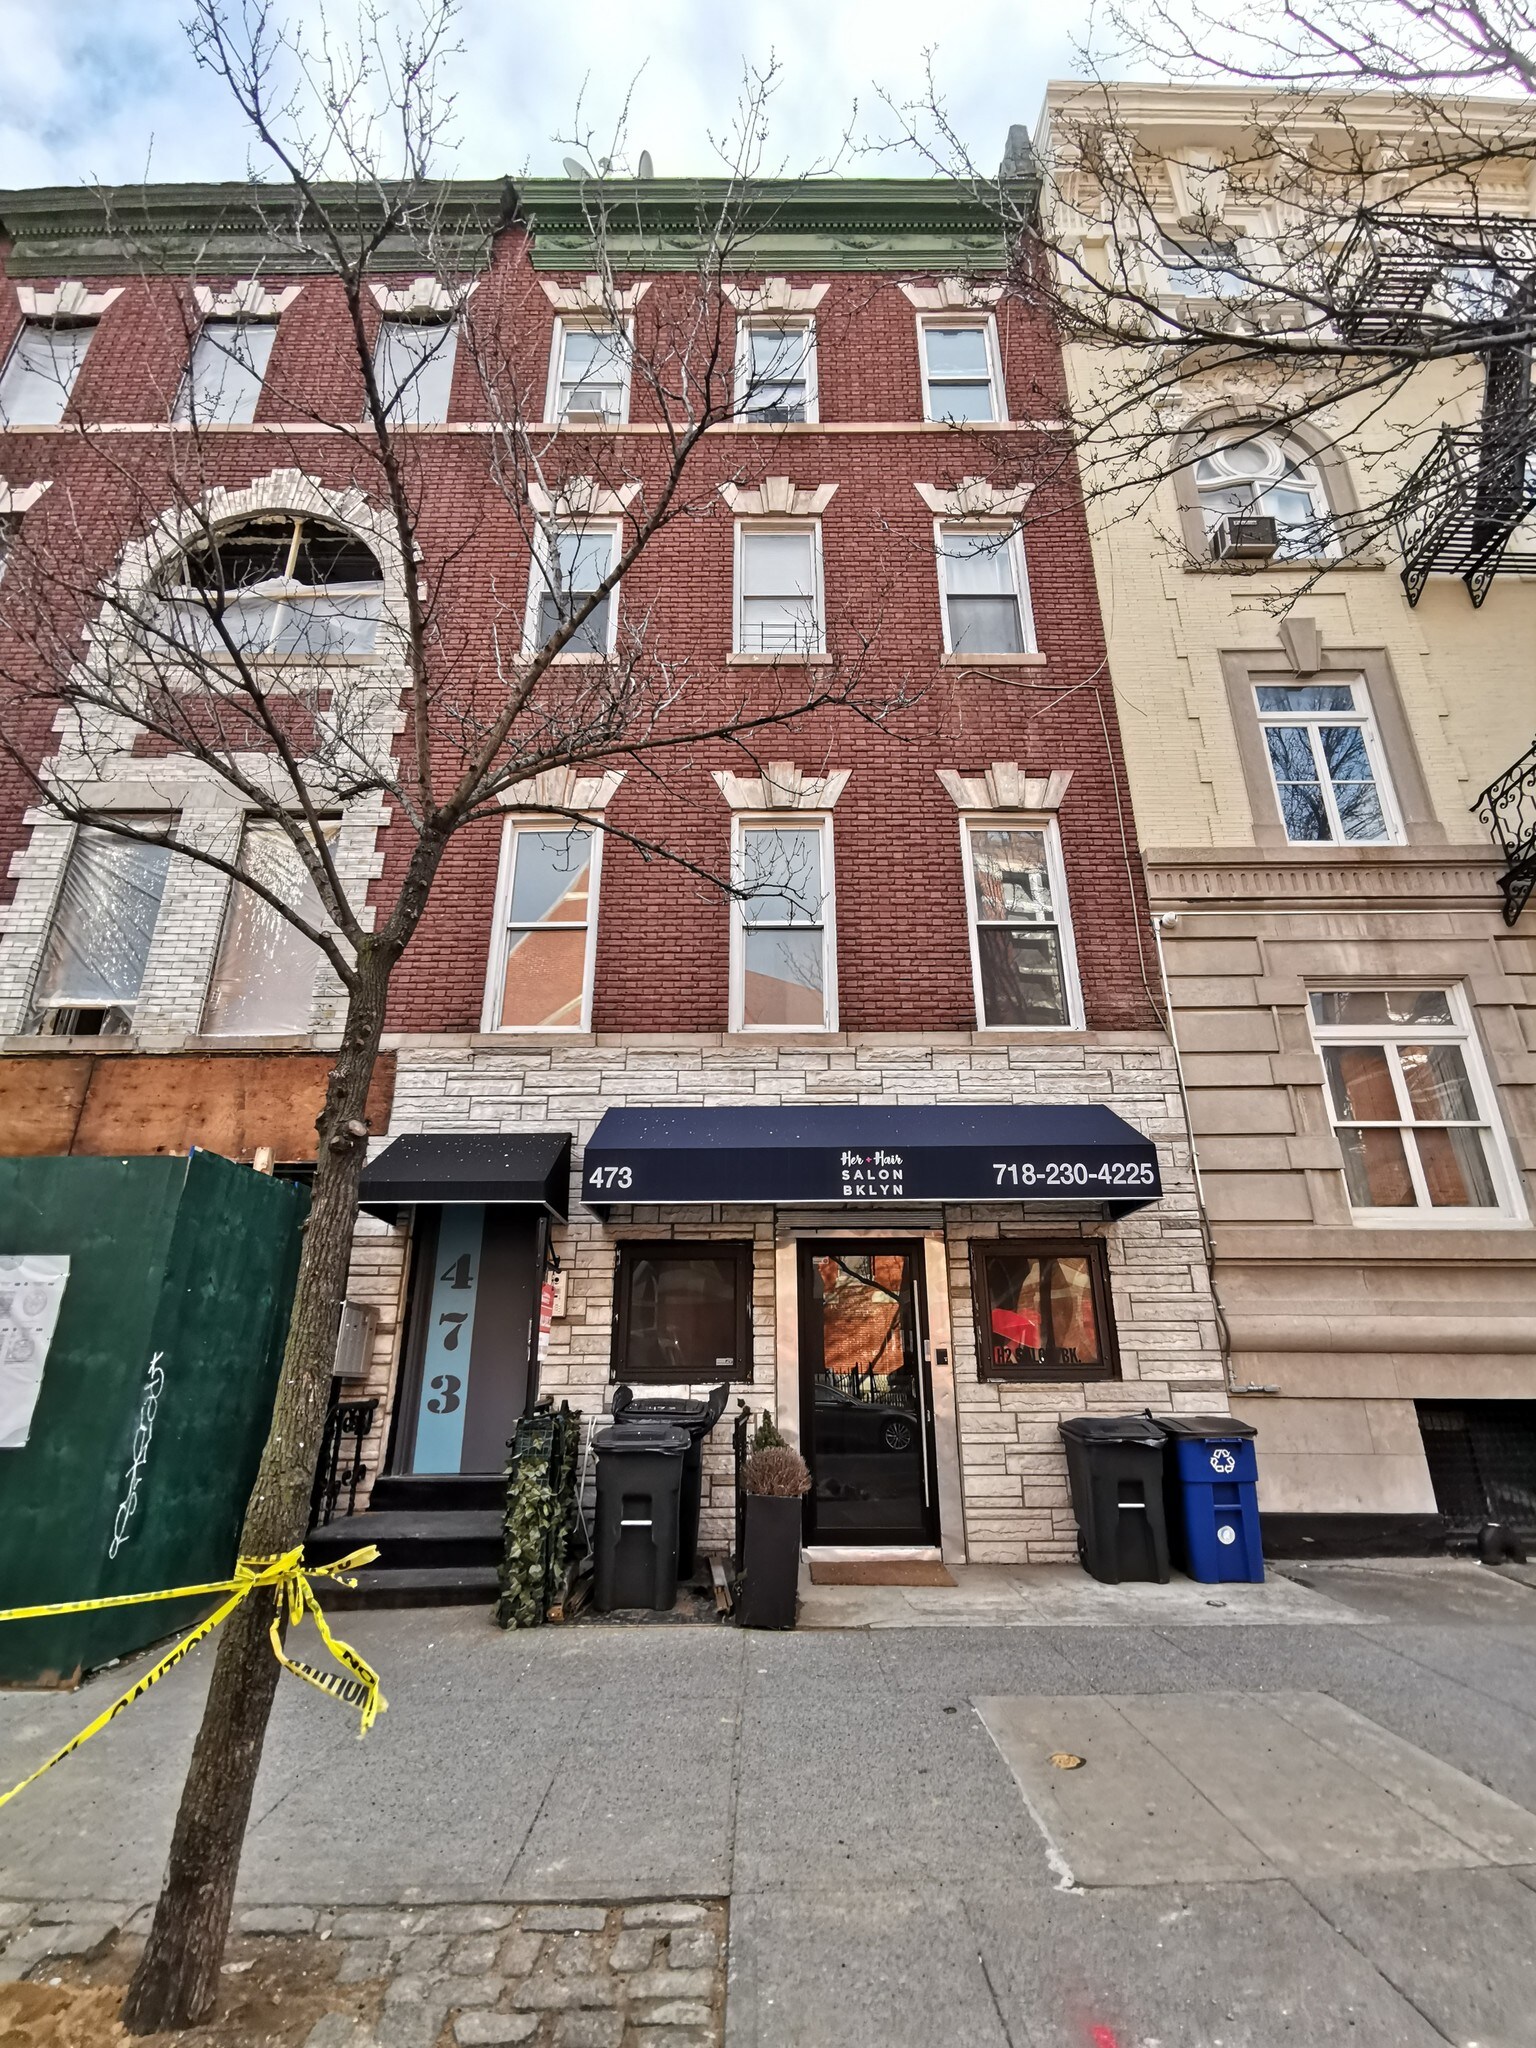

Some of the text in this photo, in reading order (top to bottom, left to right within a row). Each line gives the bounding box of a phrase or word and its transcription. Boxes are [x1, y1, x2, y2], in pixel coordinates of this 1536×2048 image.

[840, 1150, 864, 1167] Her
[874, 1150, 904, 1167] Hair
[588, 1166, 633, 1189] 473
[841, 1169, 903, 1180] SALON
[992, 1163, 1155, 1185] 718-230-4225
[843, 1184, 903, 1196] BKLYN
[427, 1253, 474, 1414] 473
